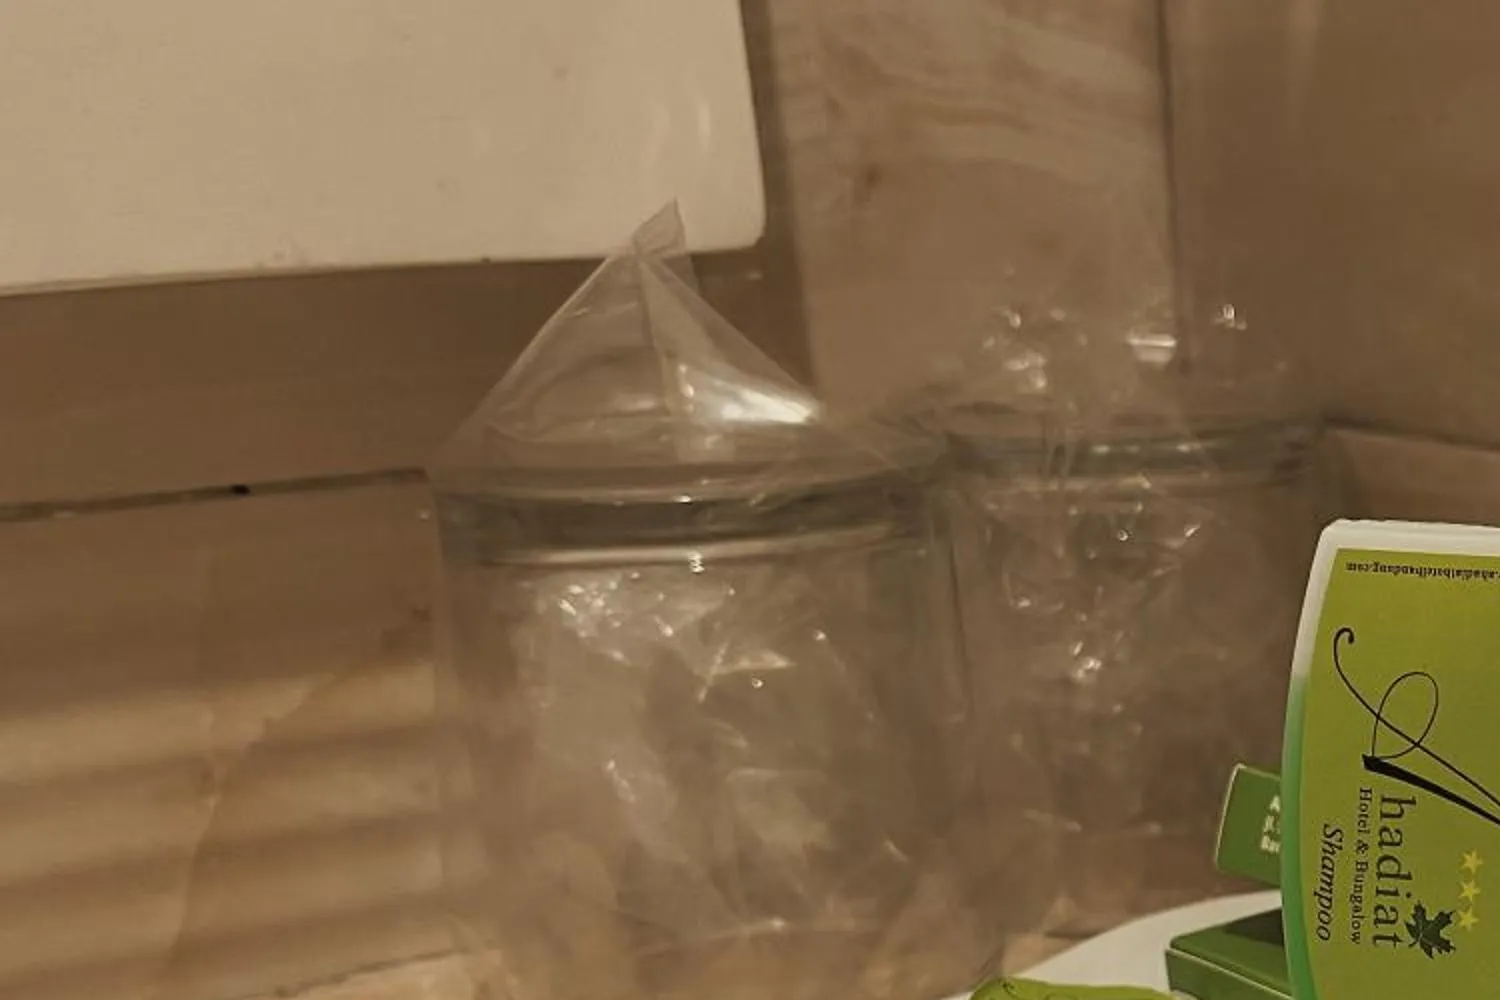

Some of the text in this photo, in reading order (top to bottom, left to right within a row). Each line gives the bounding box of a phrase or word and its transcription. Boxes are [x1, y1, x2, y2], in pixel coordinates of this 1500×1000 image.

[1316, 823, 1345, 942] Shampoo
[1349, 787, 1373, 946] Hotel & Bungalow
